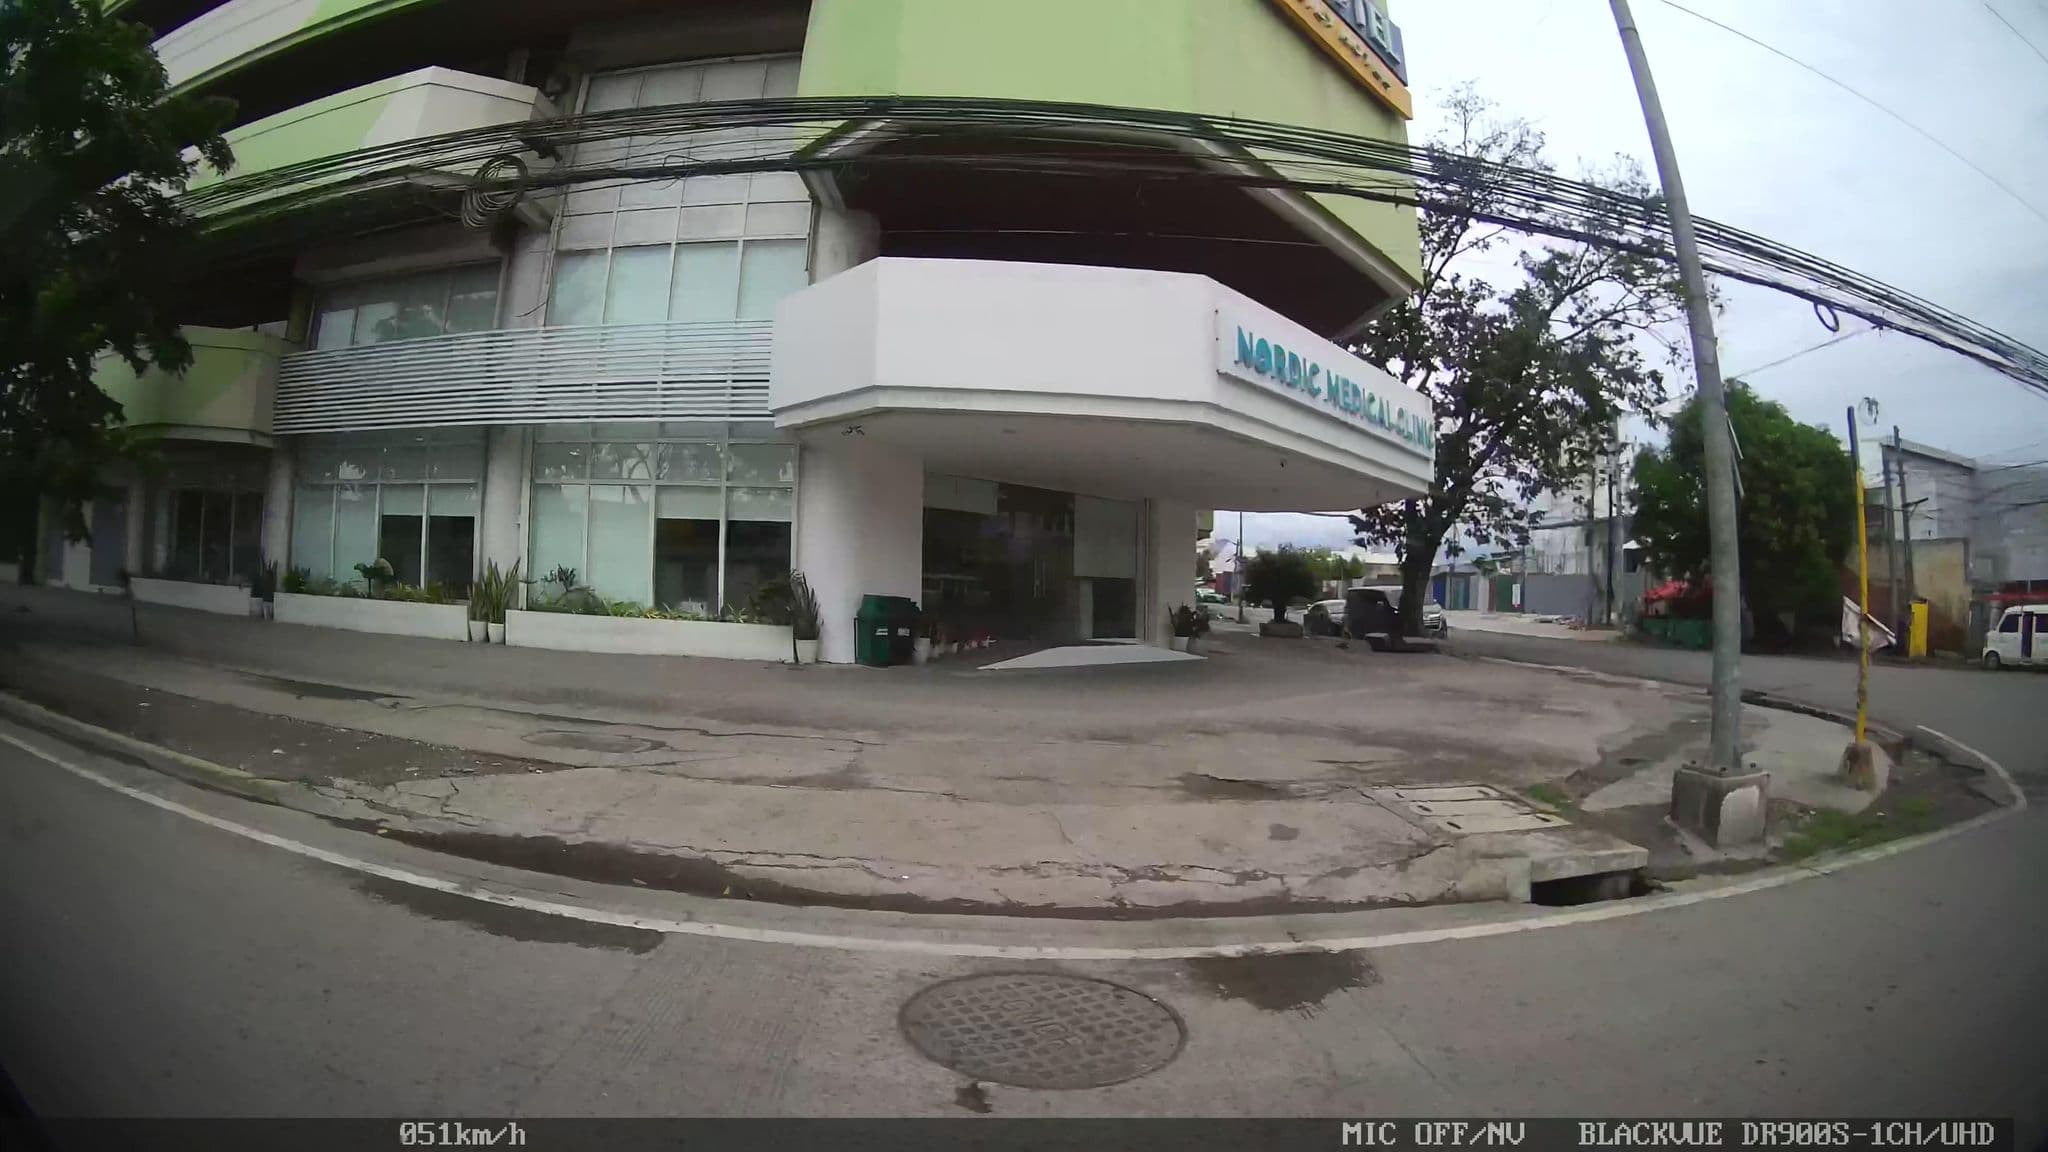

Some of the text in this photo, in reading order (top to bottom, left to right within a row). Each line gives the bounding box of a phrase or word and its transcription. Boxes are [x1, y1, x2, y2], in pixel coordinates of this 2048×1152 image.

[1236, 326, 1435, 449] NORDIC MEDICAL CLINIC
